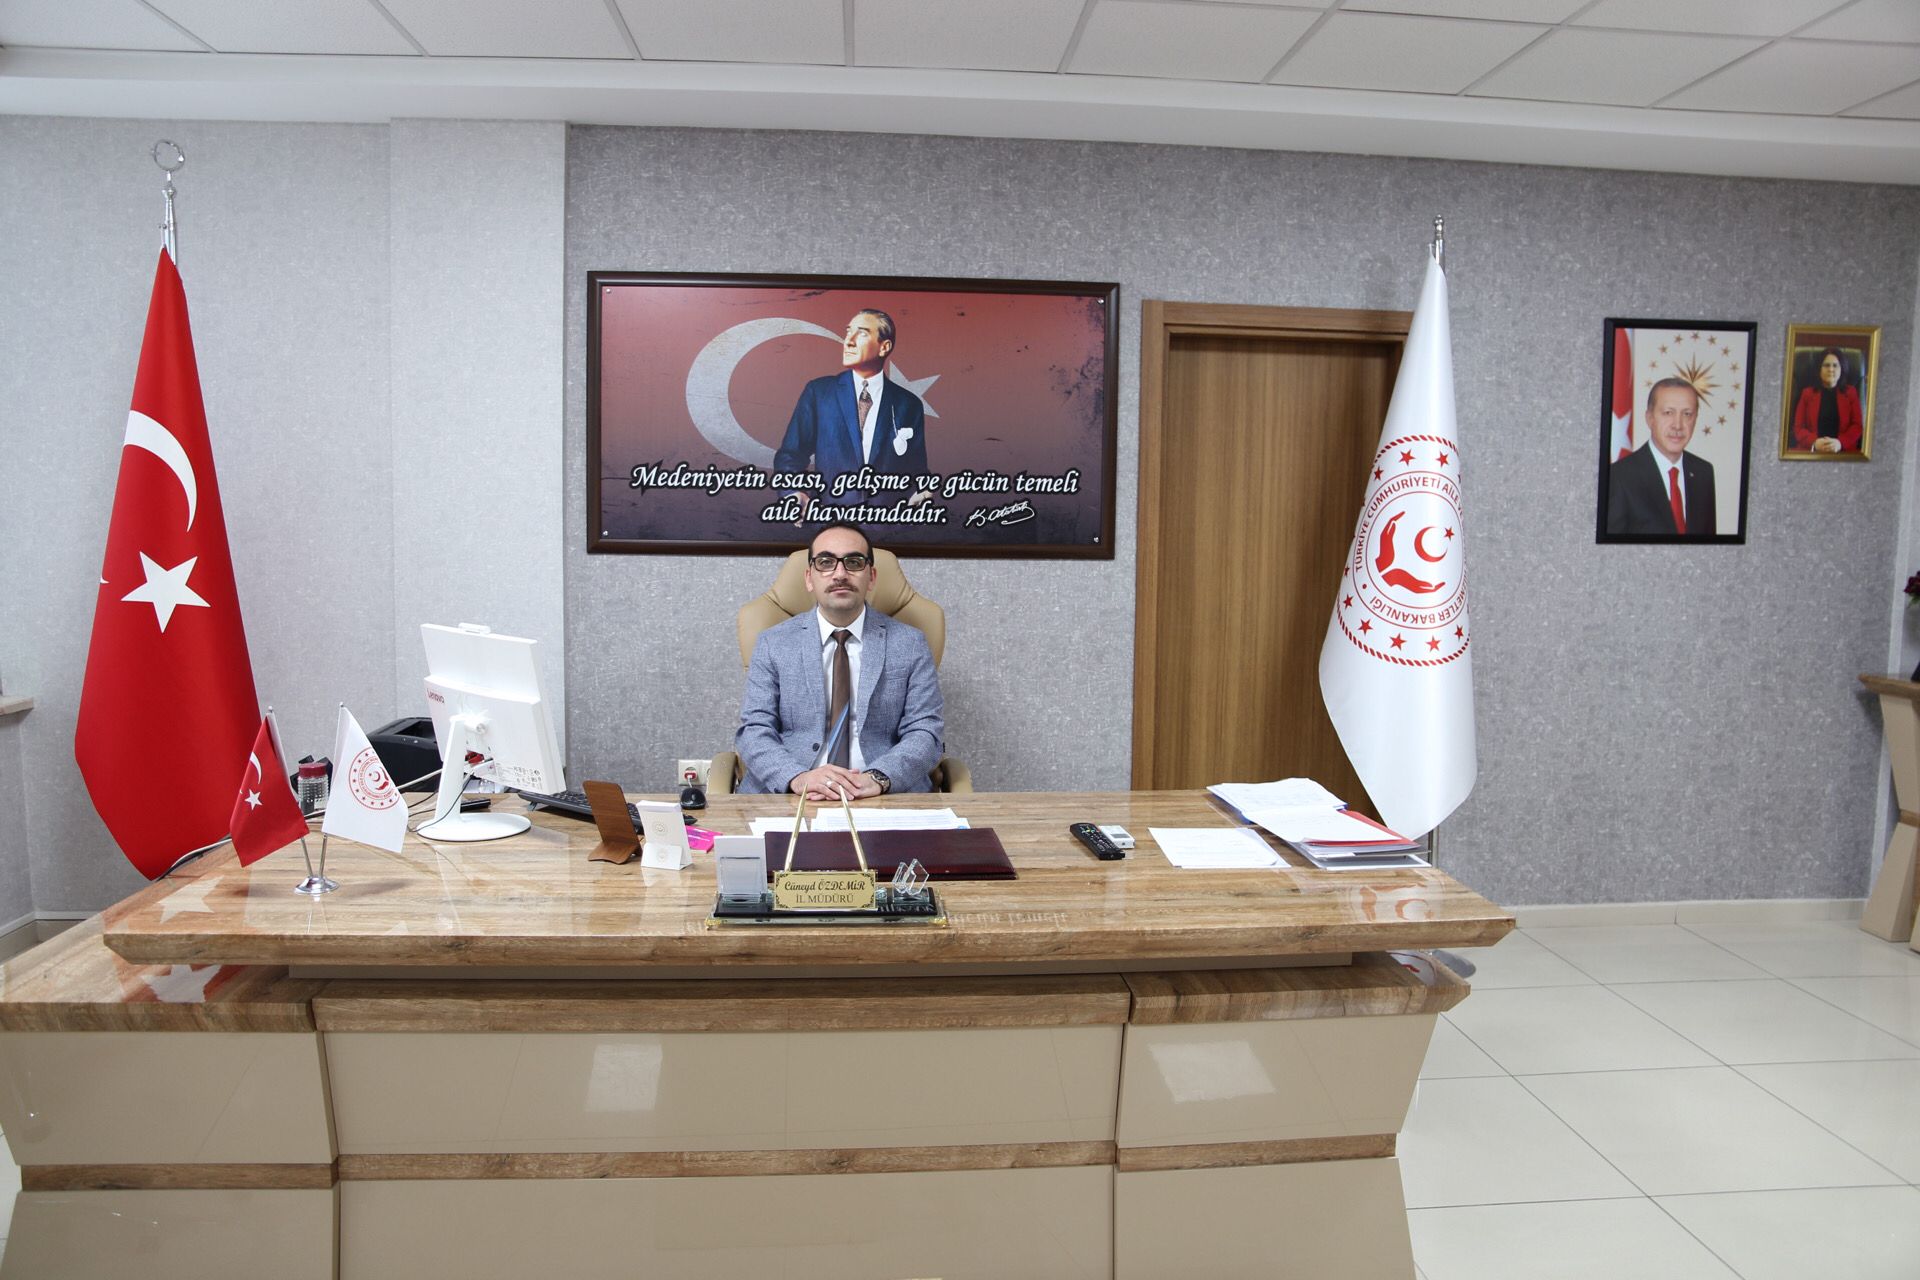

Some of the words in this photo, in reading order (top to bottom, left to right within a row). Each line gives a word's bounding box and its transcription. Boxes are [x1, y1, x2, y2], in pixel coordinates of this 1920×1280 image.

[631, 464, 766, 494] Medeniyetin
[771, 472, 826, 492] esası,
[832, 466, 910, 496] gelişme
[916, 473, 940, 490] ve
[943, 471, 1010, 498] gücün
[1015, 470, 1080, 493] temeli
[761, 499, 800, 521] aile
[1355, 521, 1370, 573] TÜRKİYE
[1367, 475, 1441, 519] CUMHURİYETİ
[1369, 596, 1436, 624] BAKANLIĞI
[784, 880, 816, 894] Cüneyd
[796, 893, 806, 903] İL
[808, 893, 854, 903] MÜDÜRÜ
